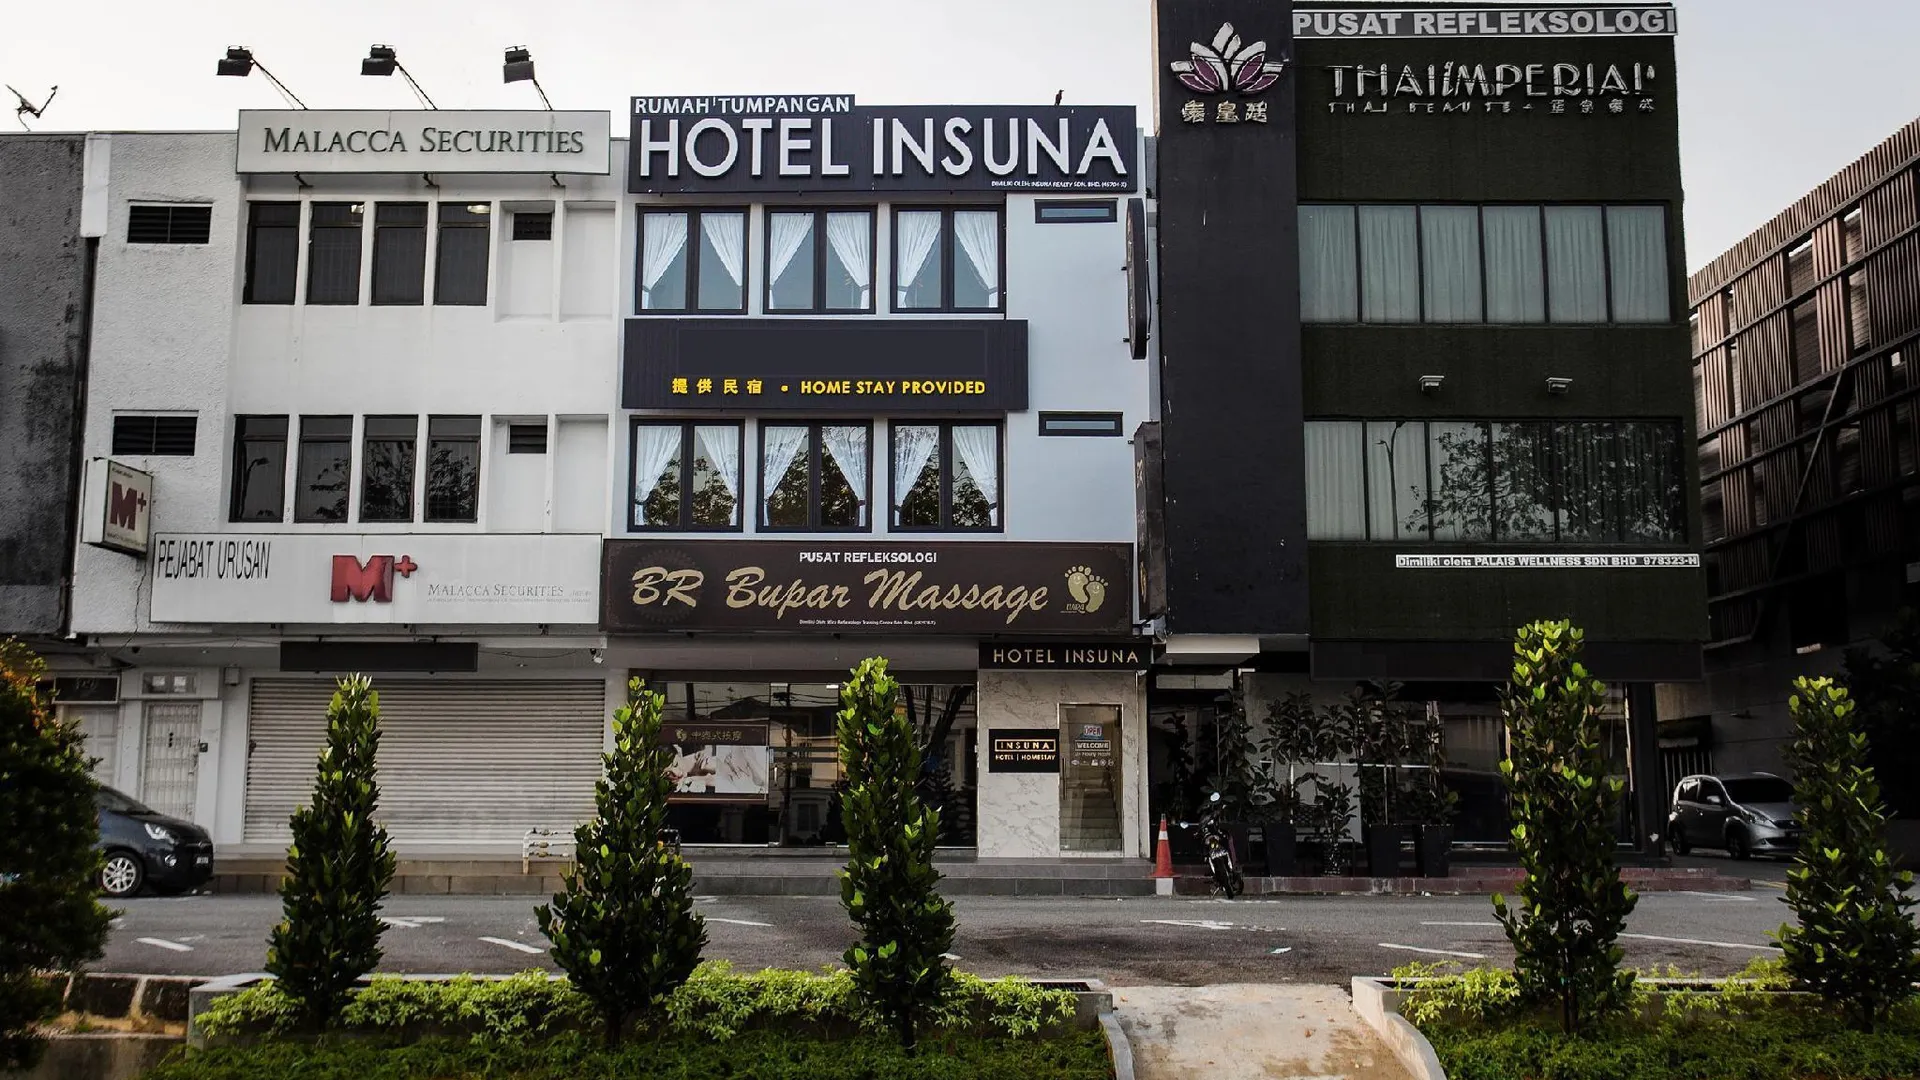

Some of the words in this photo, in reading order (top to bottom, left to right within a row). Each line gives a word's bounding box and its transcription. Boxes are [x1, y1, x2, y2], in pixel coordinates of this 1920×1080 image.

[1292, 13, 1402, 36] PUSAT
[1413, 10, 1675, 35] REFLEKSOLOGI
[635, 97, 709, 114] RUMAH
[718, 96, 850, 114] TUMPANGAN
[263, 127, 408, 154] MALACCA
[419, 126, 584, 154] SECURITIES
[640, 117, 850, 177] HOTEL
[873, 116, 1127, 175] INSUNA
[672, 378, 763, 394] 提供民宿
[800, 380, 851, 395] HOME
[856, 380, 896, 394] STAY
[902, 380, 986, 394] PROVIDED
[157, 540, 214, 579] PEJABAT
[216, 540, 271, 579] URUSAN
[799, 551, 841, 563] PUSAT
[844, 551, 937, 563] REFLEKSOLOGI
[1398, 555, 1441, 567] Dimiliki
[1443, 555, 1472, 567] oleh:
[1475, 555, 1516, 567] PALAIS
[1518, 555, 1581, 567] WELLNESS
[1584, 555, 1609, 566] SDN
[1611, 555, 1637, 566] BHD
[428, 583, 490, 597] MALACCA
[493, 583, 564, 597] SECURITIES
[632, 566, 705, 608] BR
[725, 566, 851, 620] Bupar
[863, 568, 1049, 625] Massage
[993, 649, 1056, 663] HOTEL
[1065, 649, 1139, 663] INSUNA
[1000, 741, 1050, 749] INSUNA
